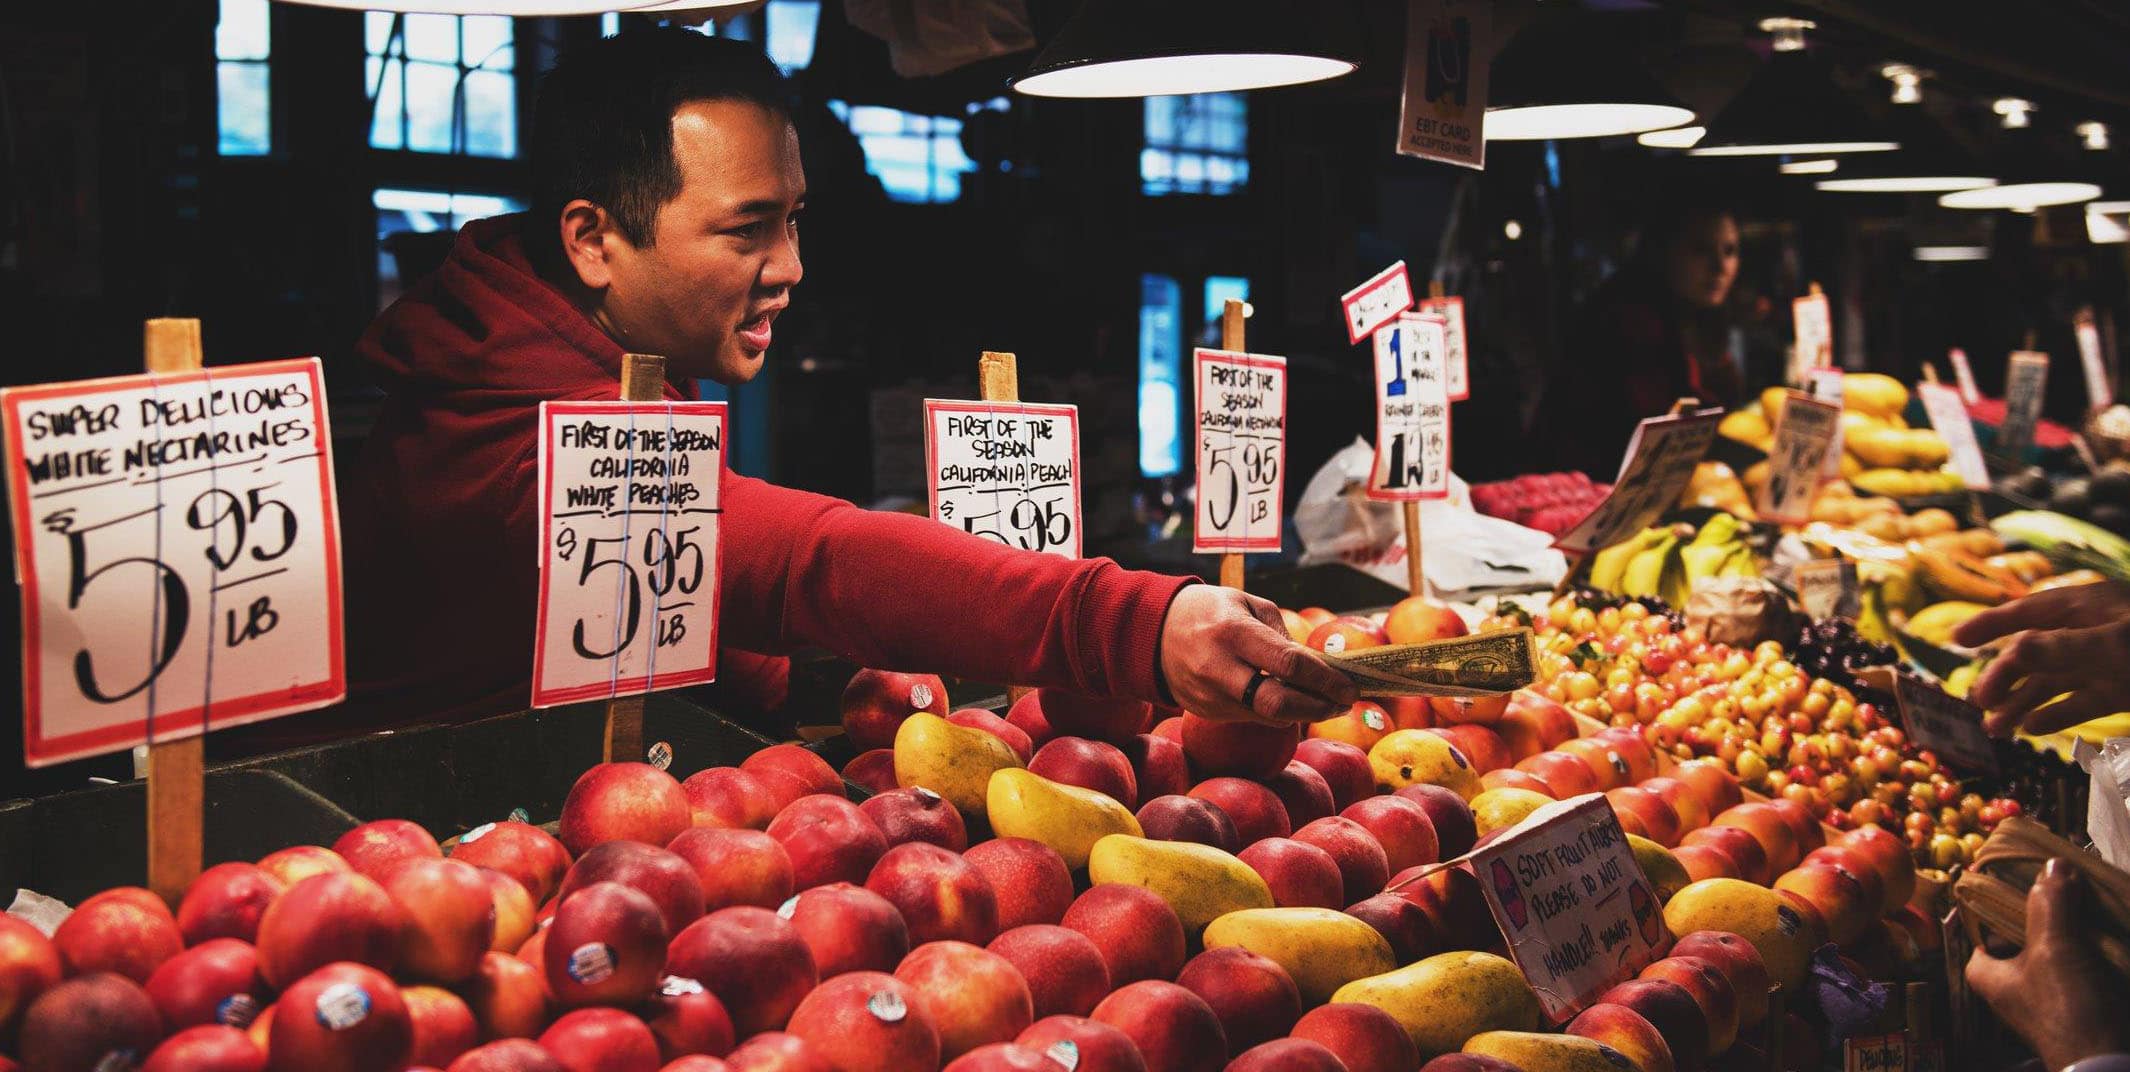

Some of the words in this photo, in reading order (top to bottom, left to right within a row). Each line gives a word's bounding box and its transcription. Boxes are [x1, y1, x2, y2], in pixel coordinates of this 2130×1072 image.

[1416, 117, 1437, 134] EBT
[1440, 123, 1471, 142] CARD
[1410, 134, 1451, 152] ACCEPTED
[1240, 369, 1252, 388] OF
[1256, 372, 1273, 391] THE
[27, 403, 120, 440] SUPER
[140, 383, 309, 427] DELICIOUS
[1221, 392, 1263, 412] SEASON
[561, 420, 611, 449] FIRST
[614, 428, 636, 451] OF
[638, 429, 666, 452] THE
[667, 426, 720, 452] SEASON
[948, 415, 992, 439] FIRST
[997, 419, 1017, 438] OF
[1026, 419, 1053, 440] THE
[25, 447, 112, 484] WHITE
[124, 419, 310, 472] NECTARINES
[971, 438, 1035, 460] SEASON
[590, 453, 689, 479] CALIFORNIA
[941, 463, 1025, 484] CALIFORNIA
[1031, 459, 1073, 483] PEACH
[567, 485, 619, 508] WHITE
[629, 482, 699, 507] PEACHES
[1251, 500, 1269, 524] LB
[226, 595, 279, 648] LB
[657, 614, 687, 648] LB
[1517, 849, 1556, 888] SOFT
[1554, 830, 1590, 867] FRUIT
[1531, 881, 1580, 922] PLEASE
[1581, 873, 1597, 896] DO
[1600, 856, 1623, 888] NOT
